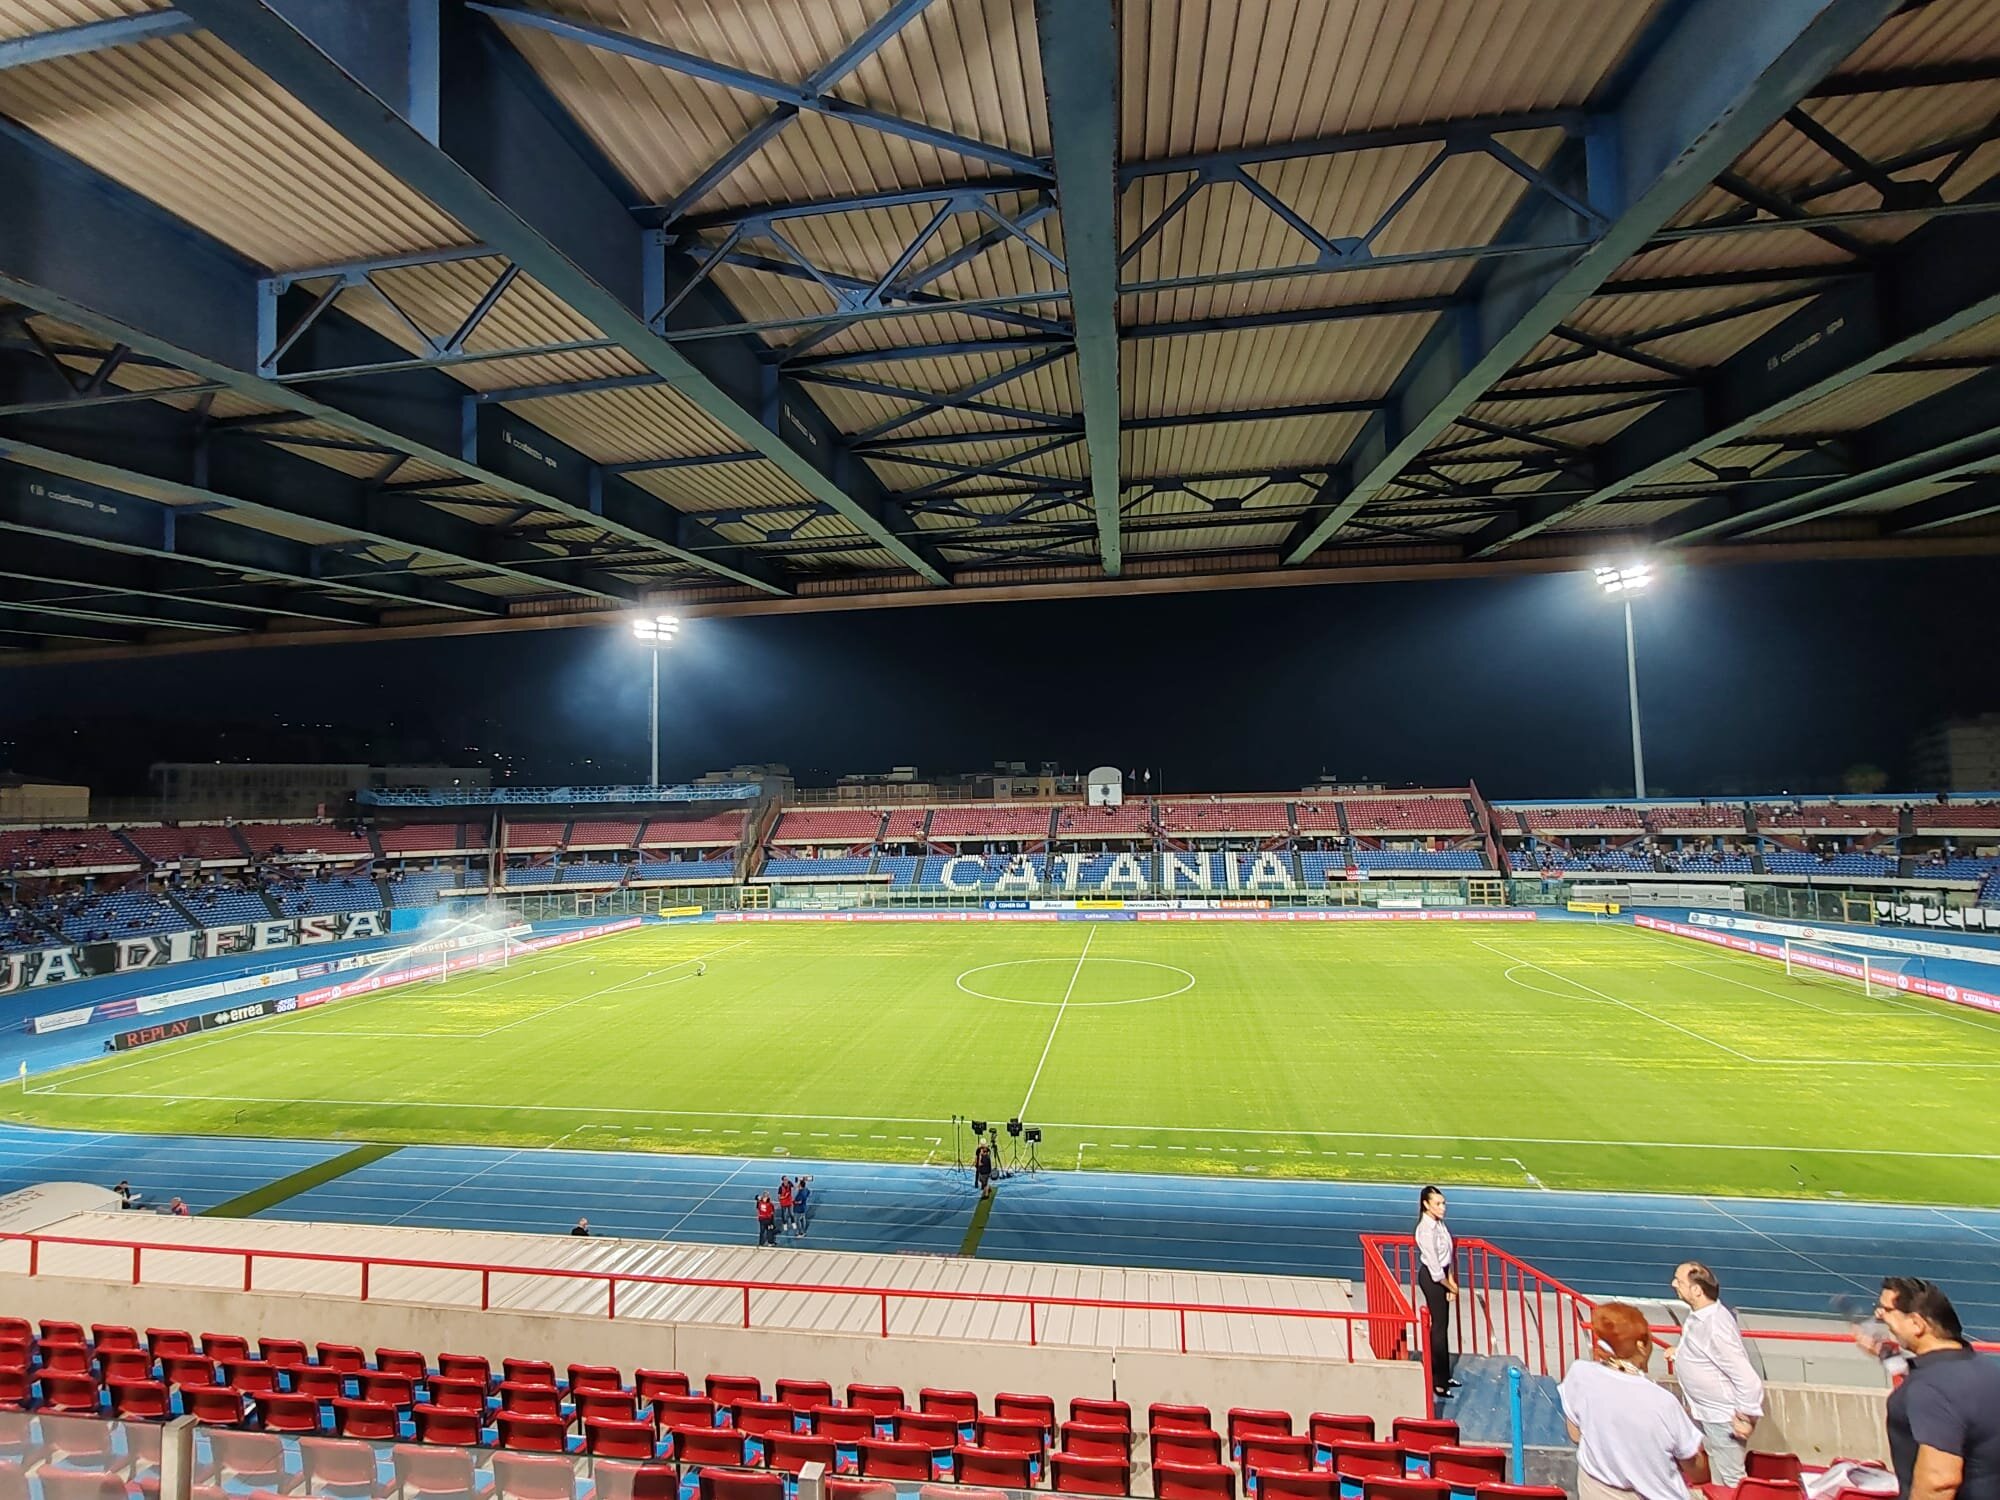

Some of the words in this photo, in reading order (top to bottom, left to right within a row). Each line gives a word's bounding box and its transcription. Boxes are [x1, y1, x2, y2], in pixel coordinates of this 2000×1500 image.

[941, 852, 1296, 892] CATANIA
[115, 910, 384, 972] DIFESA
[230, 1003, 264, 1021] errea
[127, 1021, 190, 1047] REPLAY
